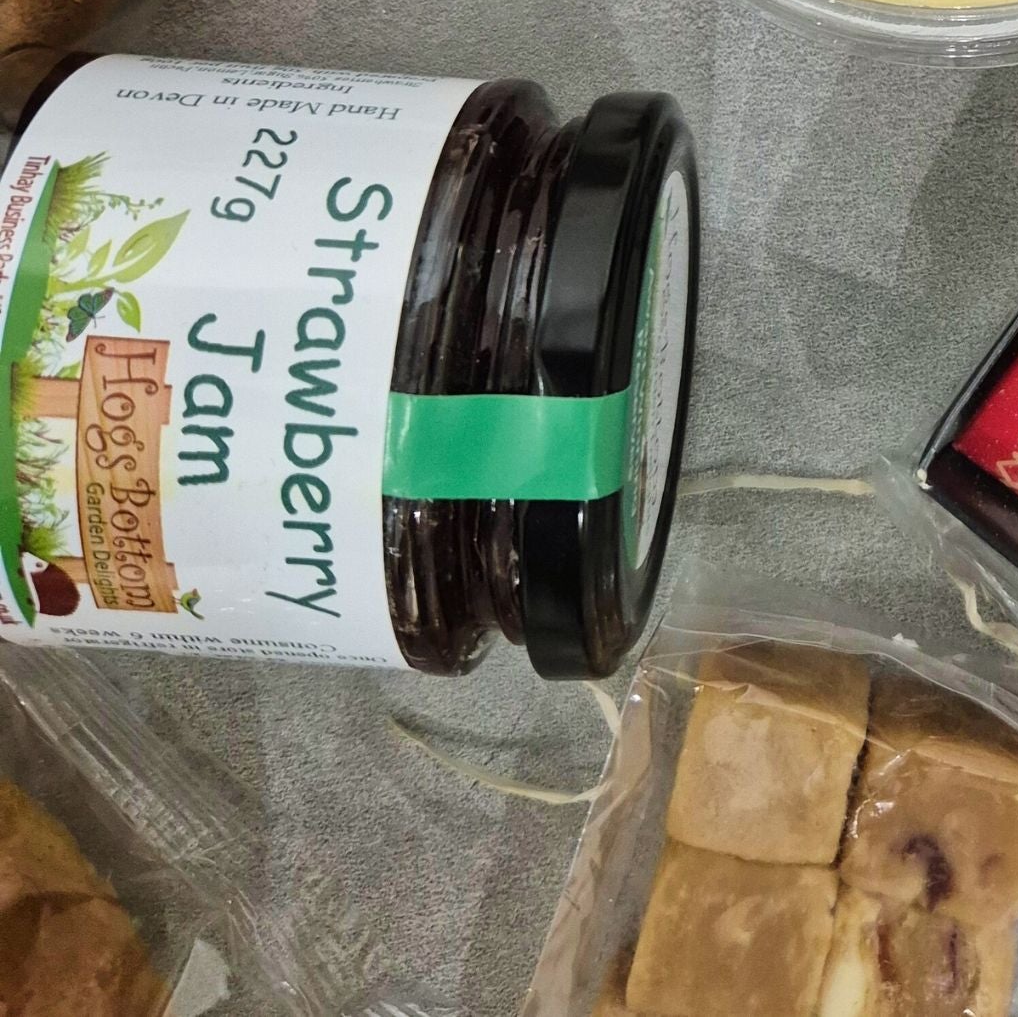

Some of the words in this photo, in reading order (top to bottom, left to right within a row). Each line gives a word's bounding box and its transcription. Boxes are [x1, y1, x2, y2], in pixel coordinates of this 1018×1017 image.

[116, 89, 203, 107] Devon
[221, 77, 353, 95] Ingredients
[214, 95, 240, 111] in
[246, 98, 321, 116] Made
[329, 103, 402, 120] Hand
[10, 155, 51, 193] Tinhay
[210, 128, 297, 223] 227g
[0, 195, 32, 249] Business
[85, 343, 159, 470] Hogs
[177, 312, 265, 486] Jam
[265, 176, 395, 618] Strawberry
[86, 482, 105, 546] Garden
[110, 478, 155, 609] Bottom
[93, 549, 119, 606] Delights
[49, 627, 120, 637] weeks
[129, 631, 144, 640] 6
[152, 632, 222, 646] within
[229, 638, 336, 652] Consume
